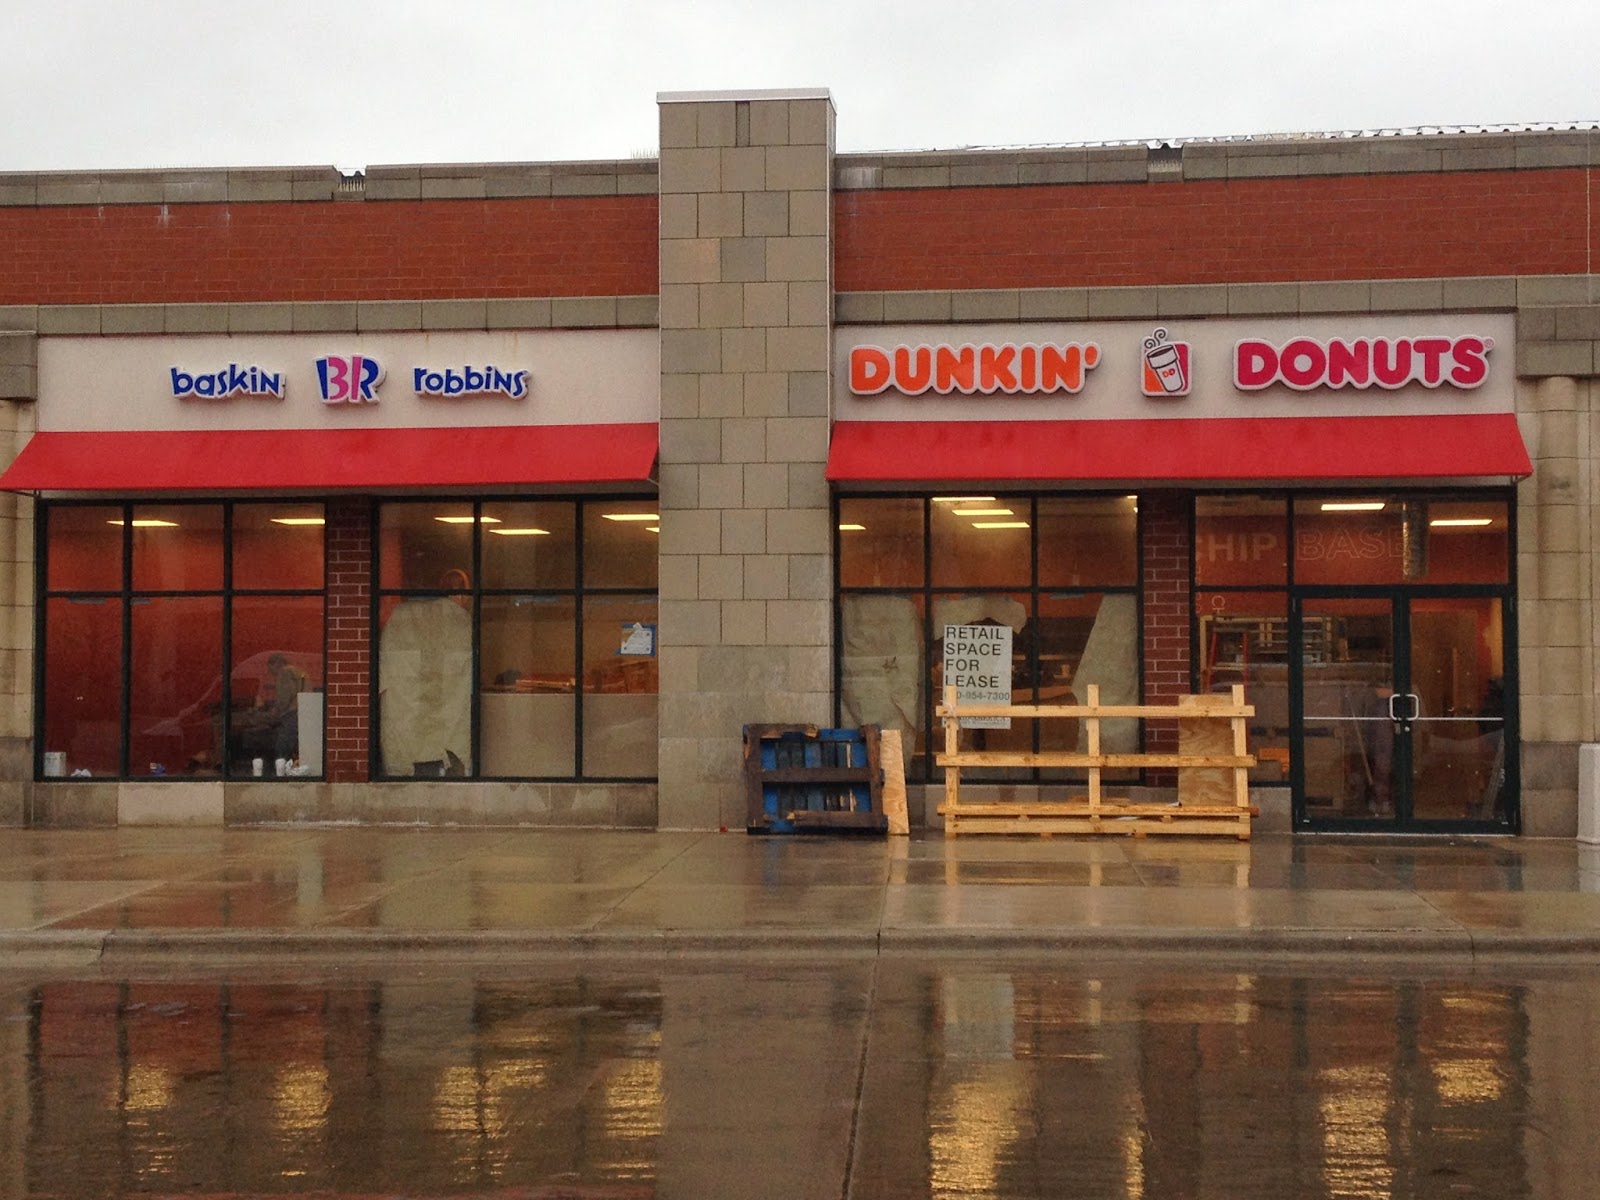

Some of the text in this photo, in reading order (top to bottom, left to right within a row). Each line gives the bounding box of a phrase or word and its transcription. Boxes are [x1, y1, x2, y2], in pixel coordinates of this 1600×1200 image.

[850, 338, 1487, 392] DUNKIN' DONUTS
[170, 355, 527, 401] baskin BR robbins
[1196, 533, 1278, 561] HIP
[945, 626, 1005, 640] RETAIL
[945, 642, 1002, 656] SPACE
[945, 658, 980, 671] FOR
